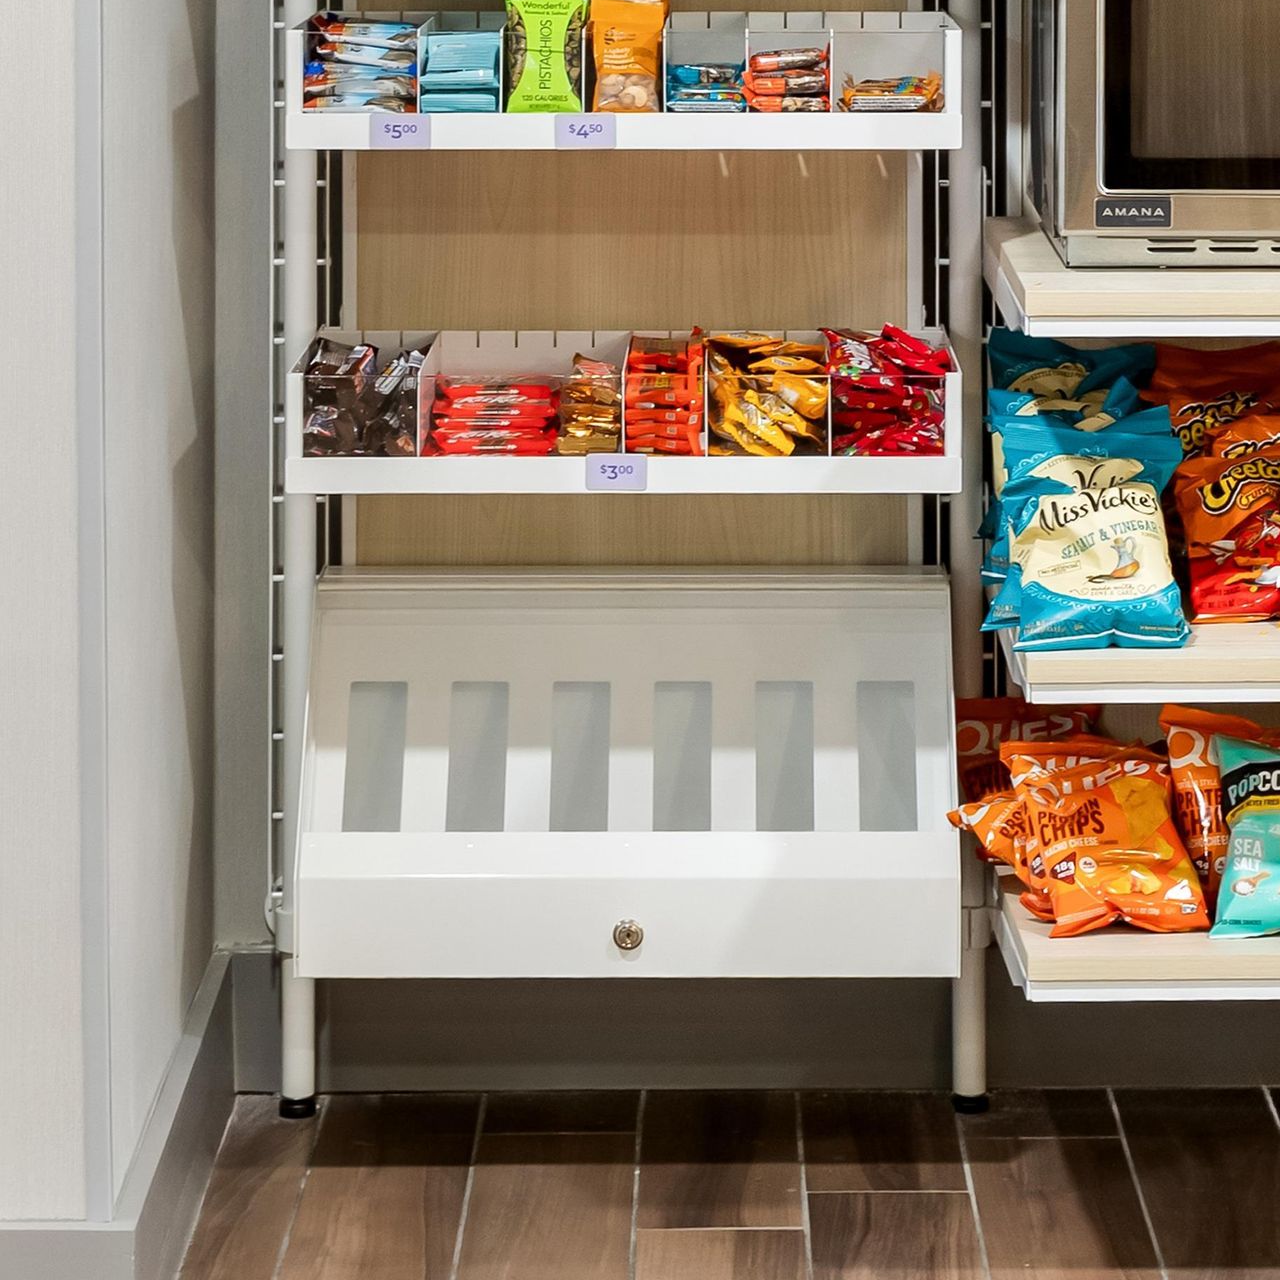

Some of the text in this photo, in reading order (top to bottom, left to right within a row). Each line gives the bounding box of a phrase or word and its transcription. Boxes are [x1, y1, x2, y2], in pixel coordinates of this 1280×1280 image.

[521, 1, 571, 11] Wonderful
[538, 19, 553, 90] PISTACHIOS
[1101, 207, 1166, 218] AMANA
[1079, 487, 1158, 515] Vickie's
[1040, 810, 1105, 846] CHIPS
[1233, 839, 1262, 856] SEA
[1233, 857, 1261, 871] SALT
